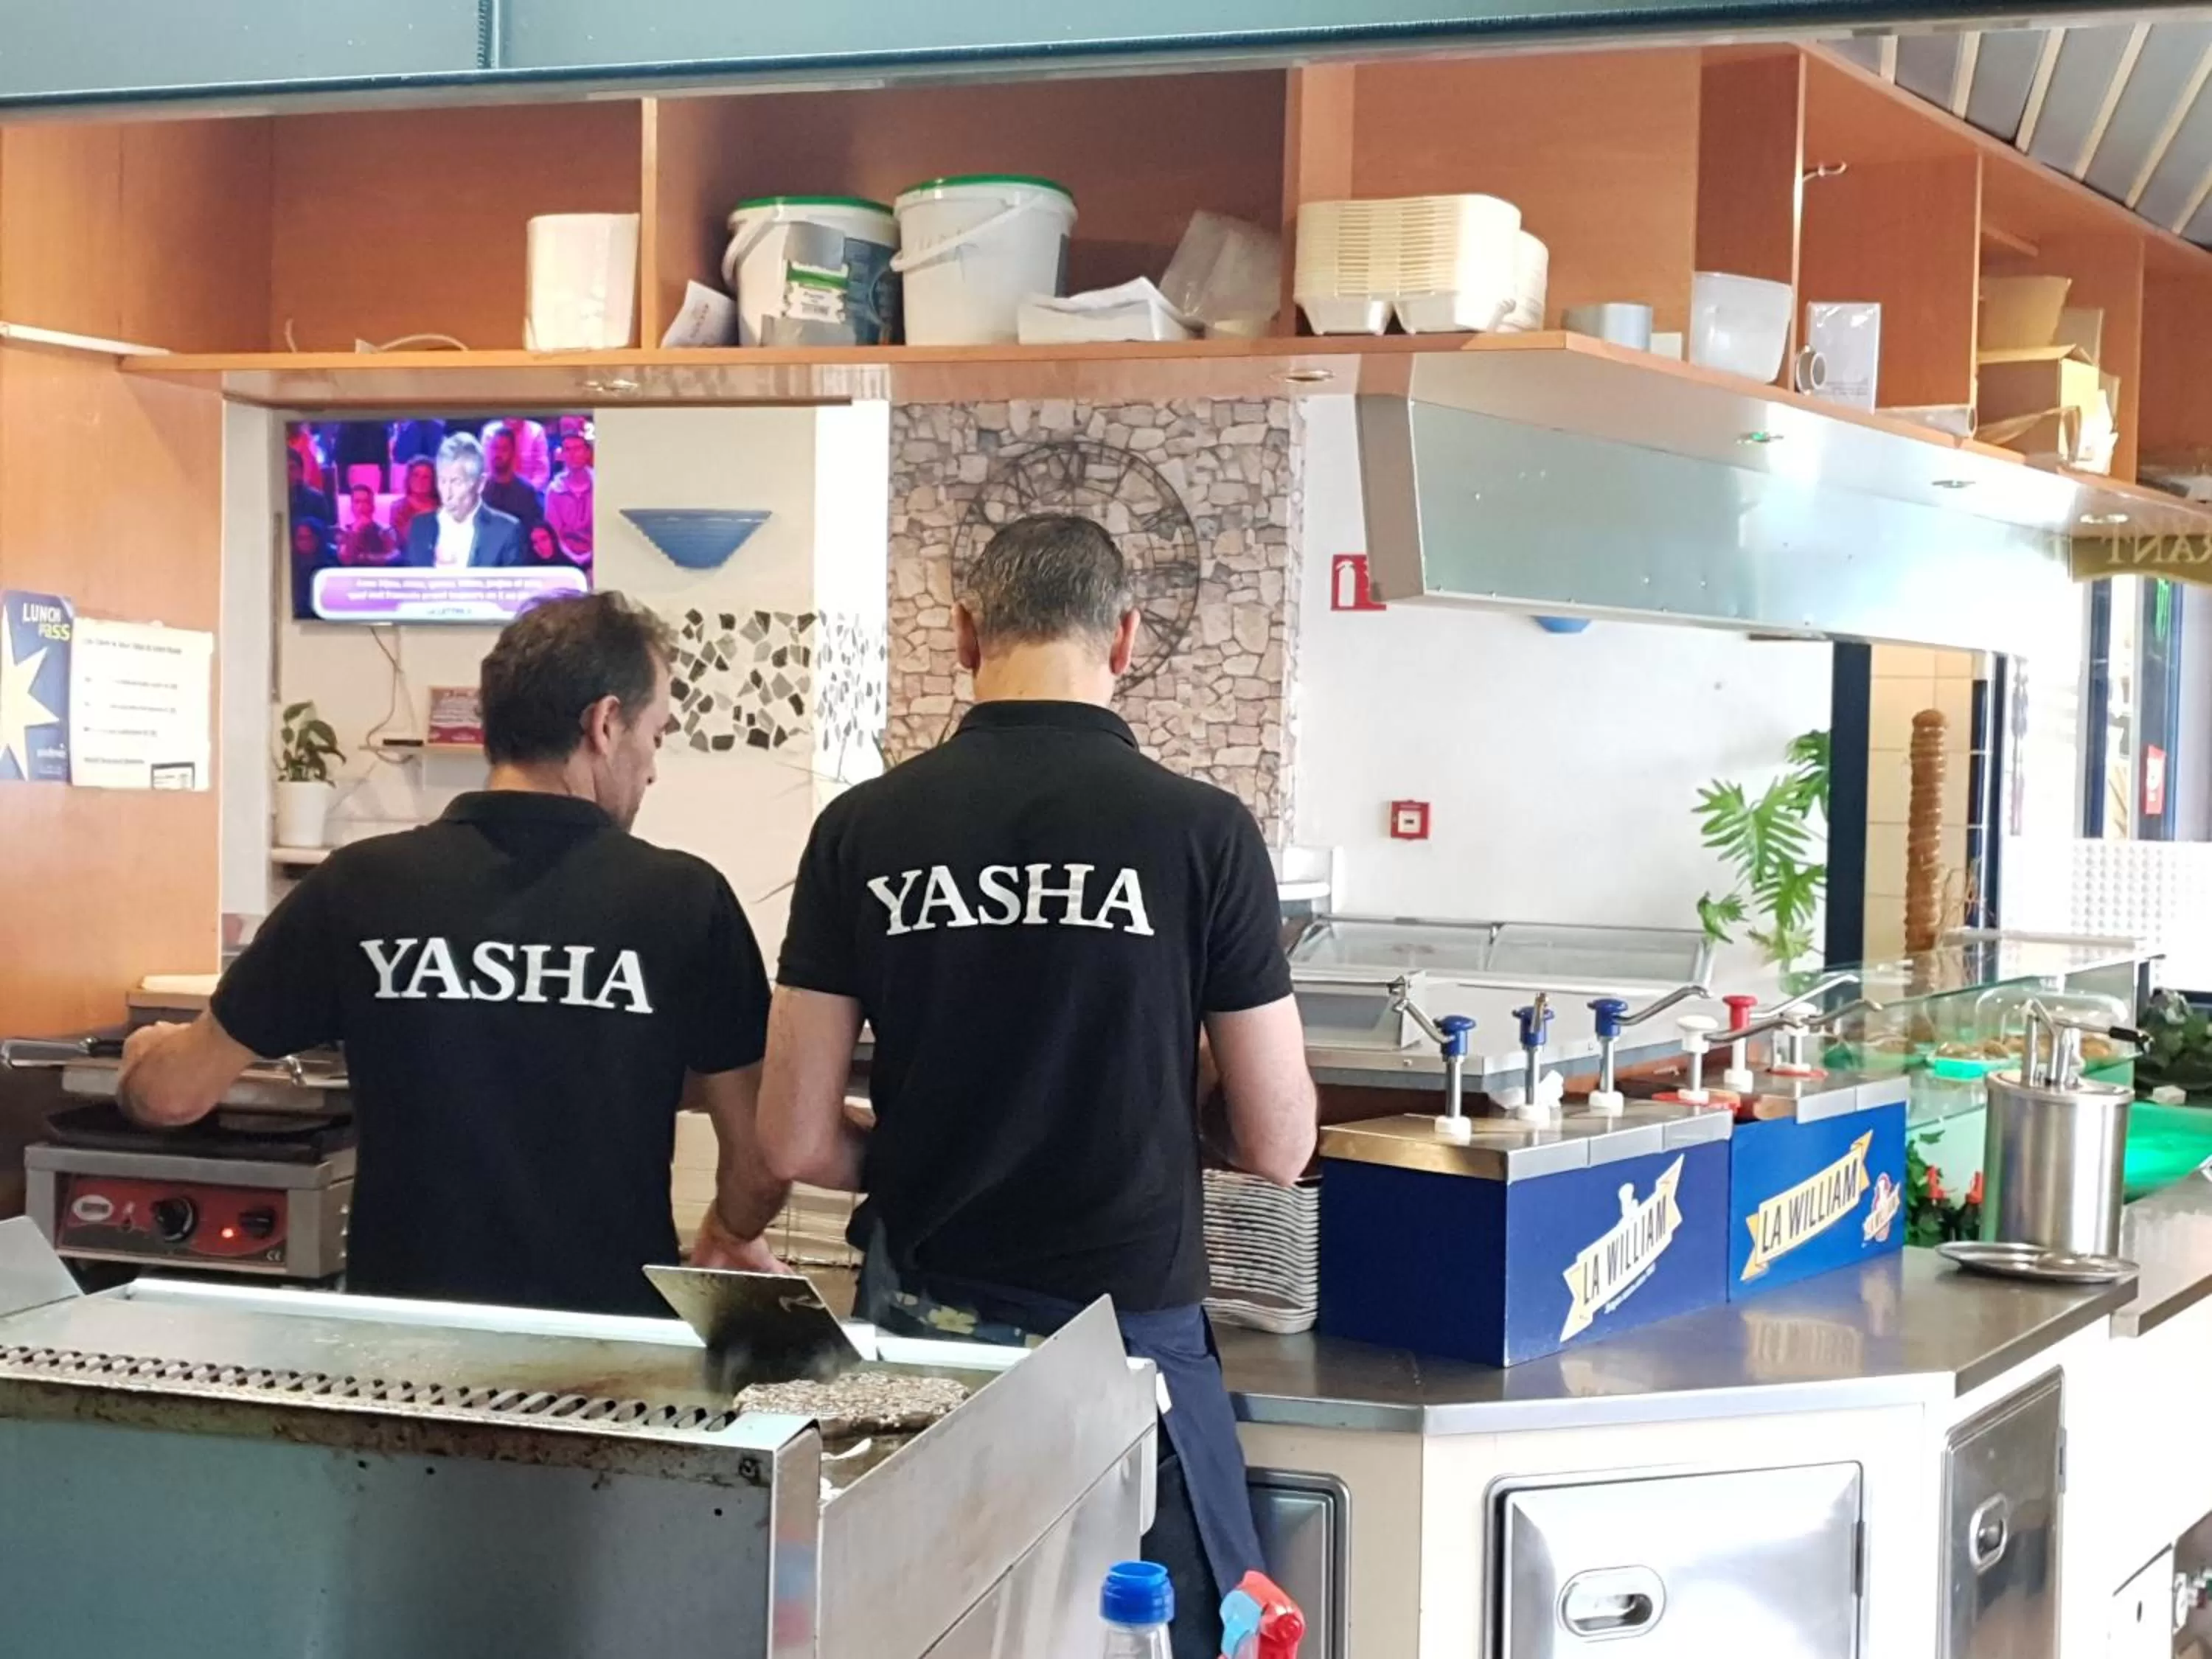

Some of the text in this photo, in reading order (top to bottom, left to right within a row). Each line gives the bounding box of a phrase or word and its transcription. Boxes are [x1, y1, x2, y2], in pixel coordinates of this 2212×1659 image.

[866, 863, 1155, 936] YASHA
[359, 937, 654, 1013] YASHA
[1762, 1203, 1781, 1253] LA
[1788, 1157, 1858, 1239] WILLIAM
[1583, 1253, 1600, 1307] LA
[1607, 1194, 1667, 1287] WILLIAM
